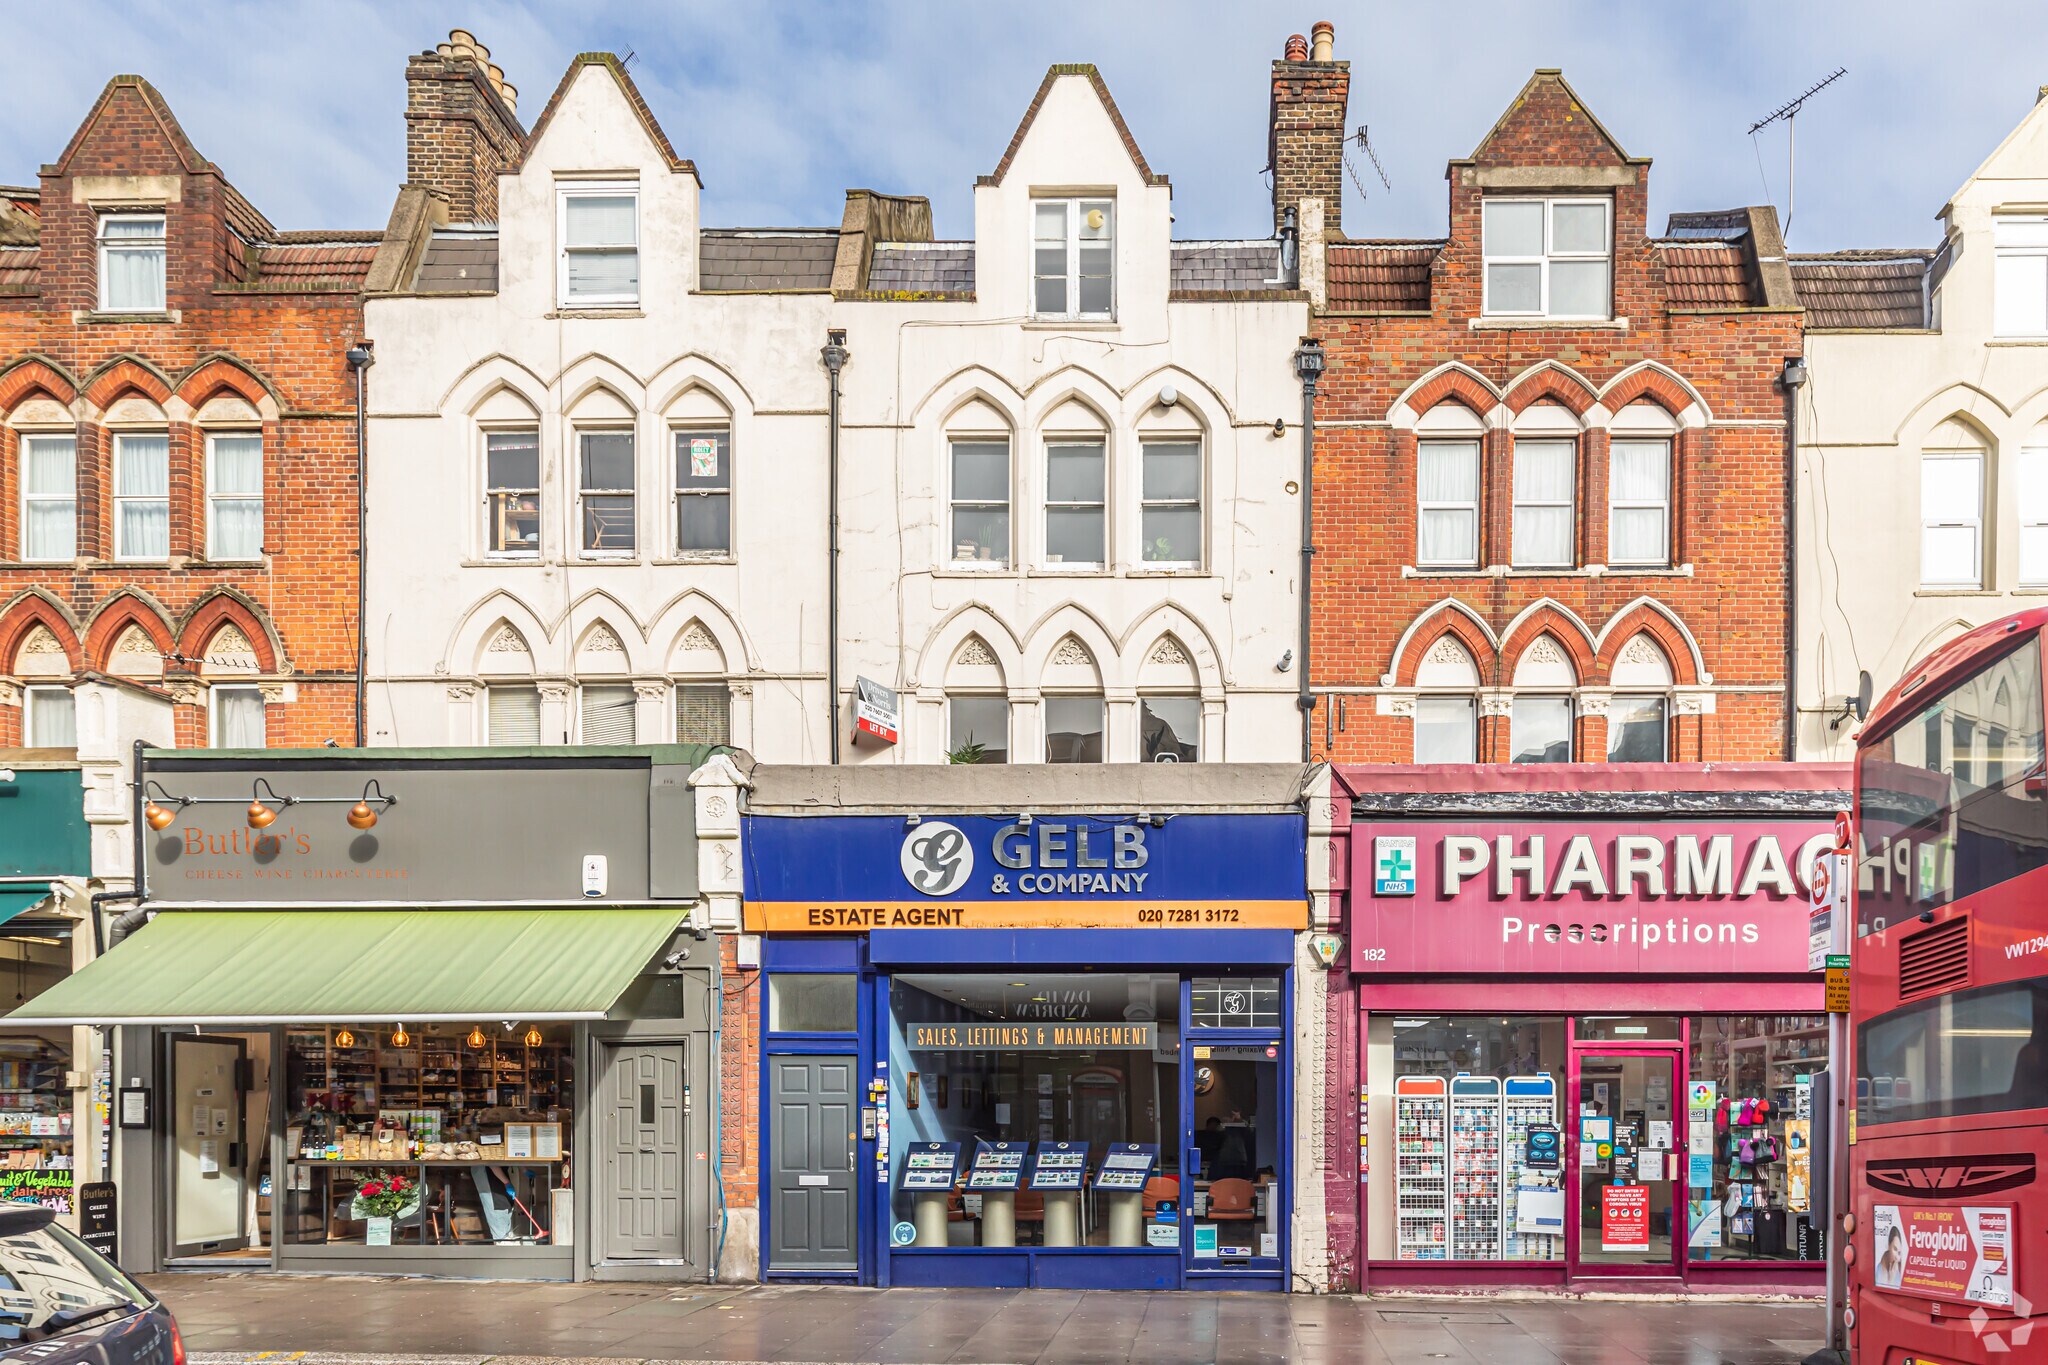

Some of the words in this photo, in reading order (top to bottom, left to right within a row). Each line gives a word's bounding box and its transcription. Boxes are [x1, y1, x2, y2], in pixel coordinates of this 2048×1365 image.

[869, 722, 879, 733] LET
[879, 727, 888, 737] BY
[183, 826, 311, 855] Butler's
[991, 824, 1149, 870] GELB
[185, 869, 243, 880] CHEESE
[254, 869, 293, 880] WINE
[1443, 834, 1836, 898] PHARMAC
[991, 873, 1011, 894] &
[1018, 873, 1150, 894] COMPANY
[1385, 882, 1406, 890] NHS
[808, 908, 886, 926] ESTATE
[891, 908, 964, 926] AGENT
[1137, 909, 1163, 923] 020
[1166, 909, 1202, 923] 7281
[1204, 909, 1239, 923] 3172
[1503, 917, 1759, 949] Prescriptions
[1362, 948, 1386, 961] 182
[917, 1028, 963, 1047] SALES,
[967, 1027, 1029, 1046] LETTINGS
[1037, 1028, 1045, 1045] &
[1054, 1027, 1149, 1046] MANAGEMENT
[23, 1170, 74, 1190] Vegetable
[12, 1186, 69, 1197] dairy-free
[82, 1187, 115, 1200] Butler's
[1874, 1210, 1893, 1226] Feeling
[1799, 1223, 1807, 1261] ORTUNA
[1909, 1224, 1968, 1256] Feroglobin
[1909, 1255, 1937, 1268] CAPSULES
[1937, 1260, 1945, 1268] or
[1944, 1259, 1967, 1271] LIQUID
[1969, 1289, 2009, 1303] VITABIOTICS
